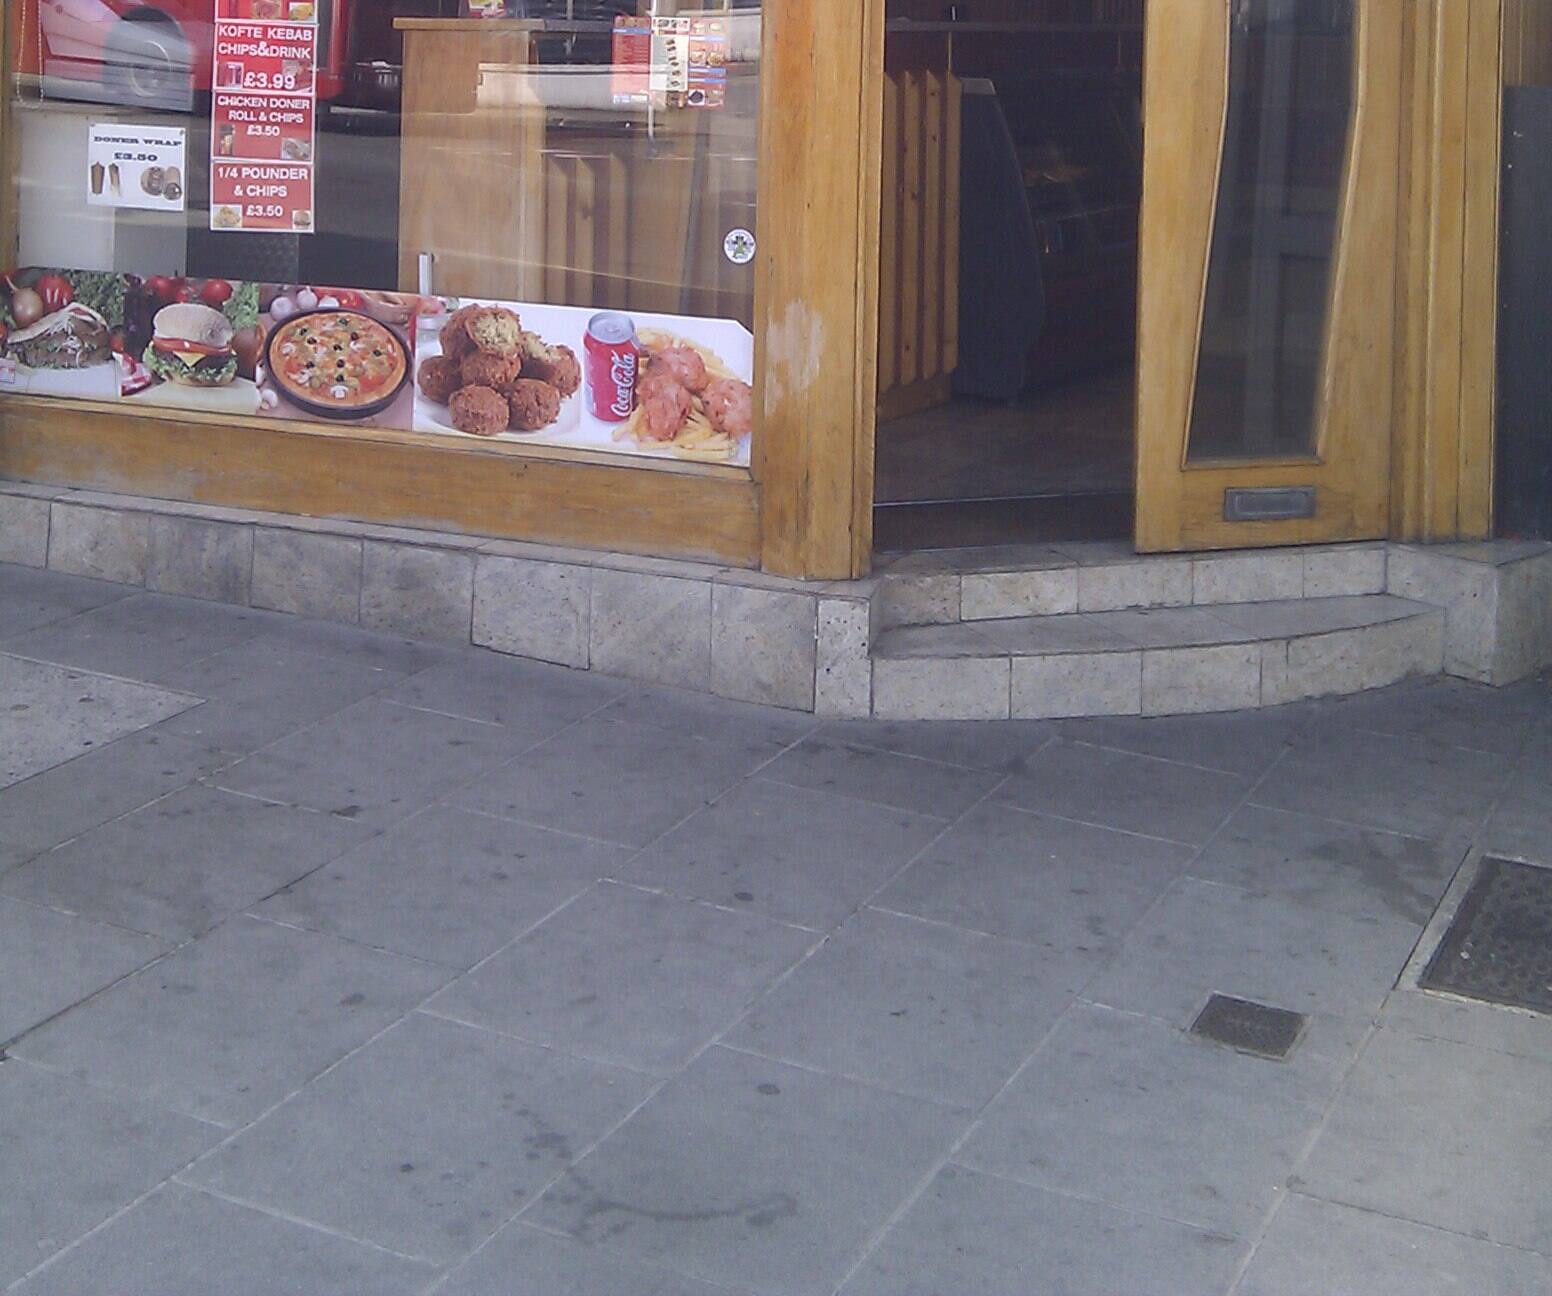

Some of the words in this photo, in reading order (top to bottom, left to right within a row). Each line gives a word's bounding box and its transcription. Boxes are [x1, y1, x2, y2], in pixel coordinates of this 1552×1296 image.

[218, 25, 263, 38] KOFTE
[267, 27, 312, 40] KEBAB
[218, 41, 311, 59] CHIPS&DRINK
[243, 72, 296, 89] £3.99
[217, 95, 267, 108] CHICKEN
[269, 98, 310, 110] DONER
[228, 110, 257, 122] ROLL
[259, 112, 267, 123] &
[269, 112, 304, 124] CHIPS
[246, 125, 280, 136] £3.50
[114, 152, 158, 161] £3.50
[218, 168, 238, 179] 1/4
[241, 168, 308, 180] POUNDER
[234, 186, 243, 197] &
[246, 185, 287, 197] CHIPS
[246, 205, 283, 217] £3.50
